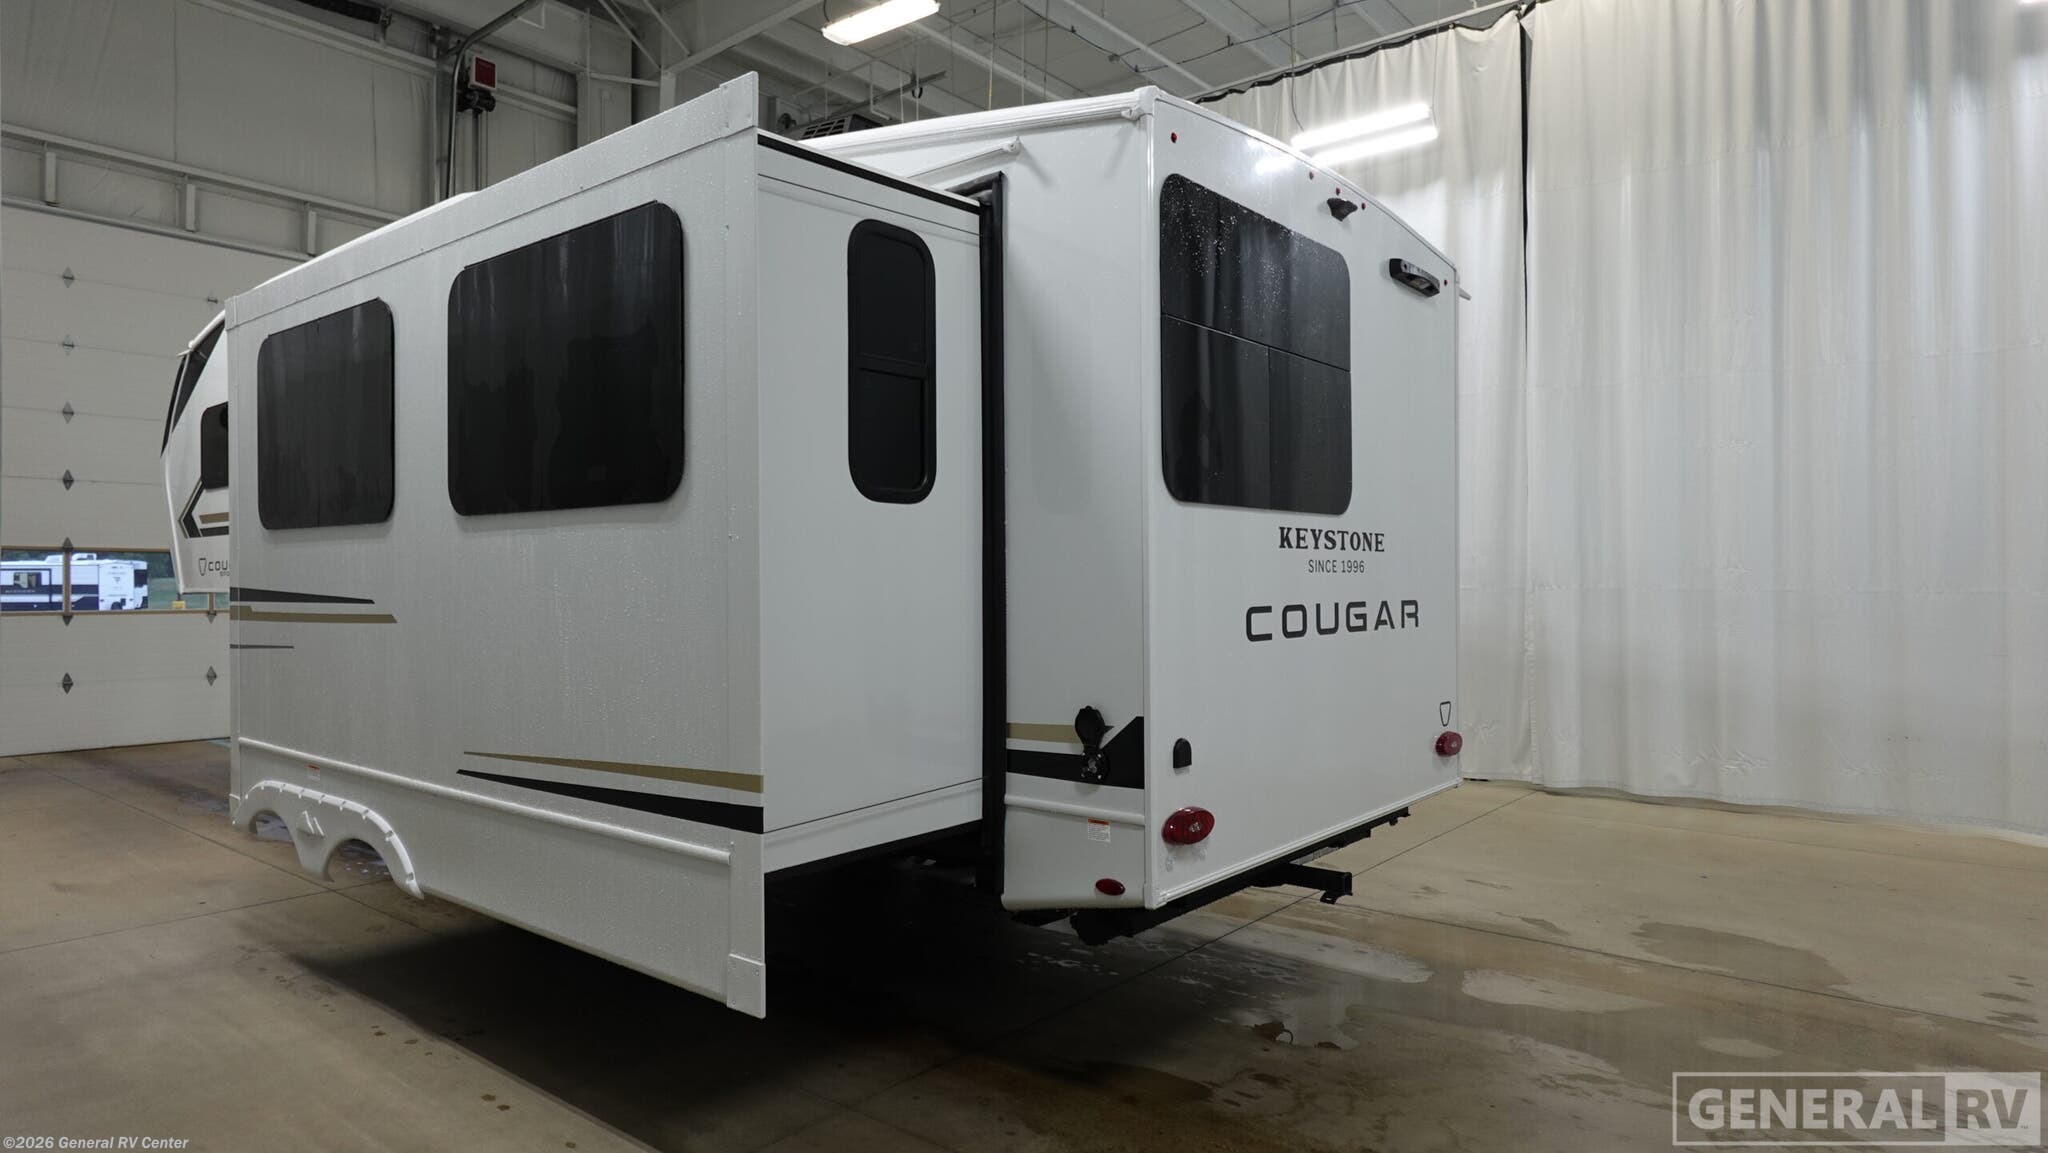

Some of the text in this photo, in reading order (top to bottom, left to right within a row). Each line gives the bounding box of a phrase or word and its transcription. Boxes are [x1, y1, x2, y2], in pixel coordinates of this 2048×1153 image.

[1279, 526, 1385, 552] KEYSTONE
[208, 560, 230, 571] COU
[1308, 559, 1365, 573] SINCE 1996
[1246, 600, 1419, 642] COUGAR
